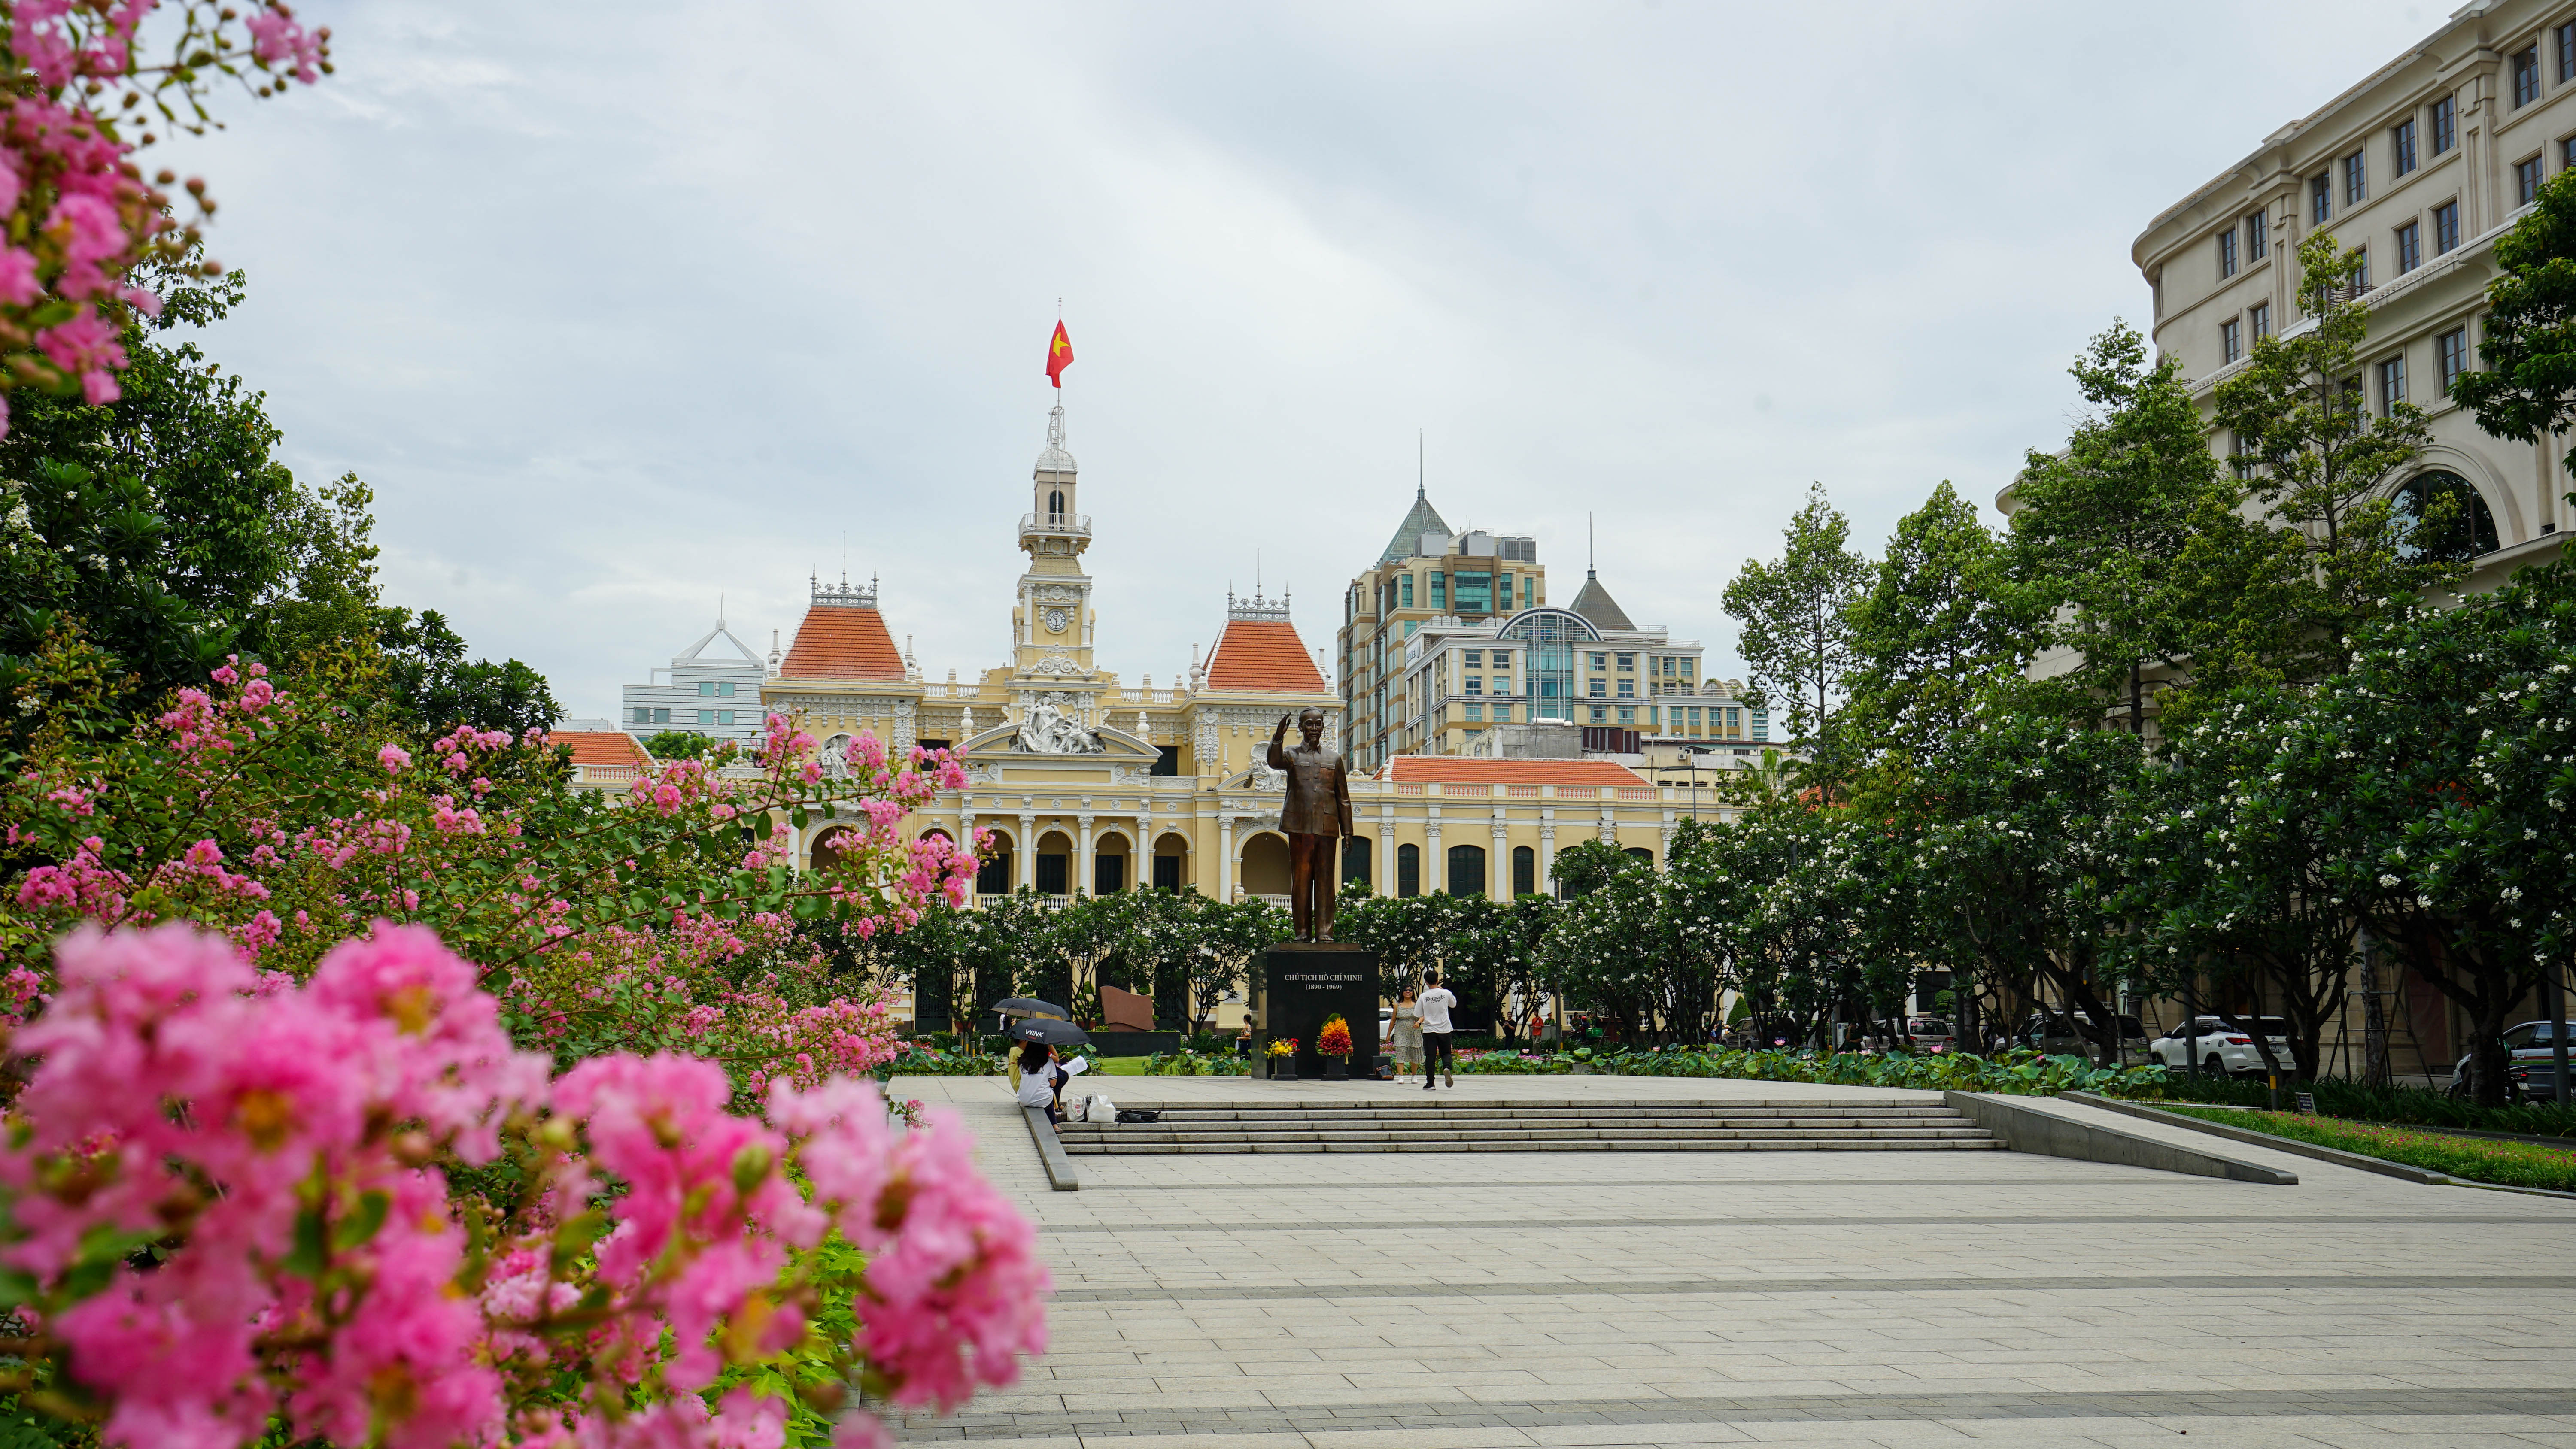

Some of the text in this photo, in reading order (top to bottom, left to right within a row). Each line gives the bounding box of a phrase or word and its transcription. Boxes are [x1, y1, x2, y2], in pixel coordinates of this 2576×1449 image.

[1318, 972, 1329, 981] HỒ
[1330, 973, 1342, 981] CHÍ
[1025, 1029, 1044, 1037] WINK
